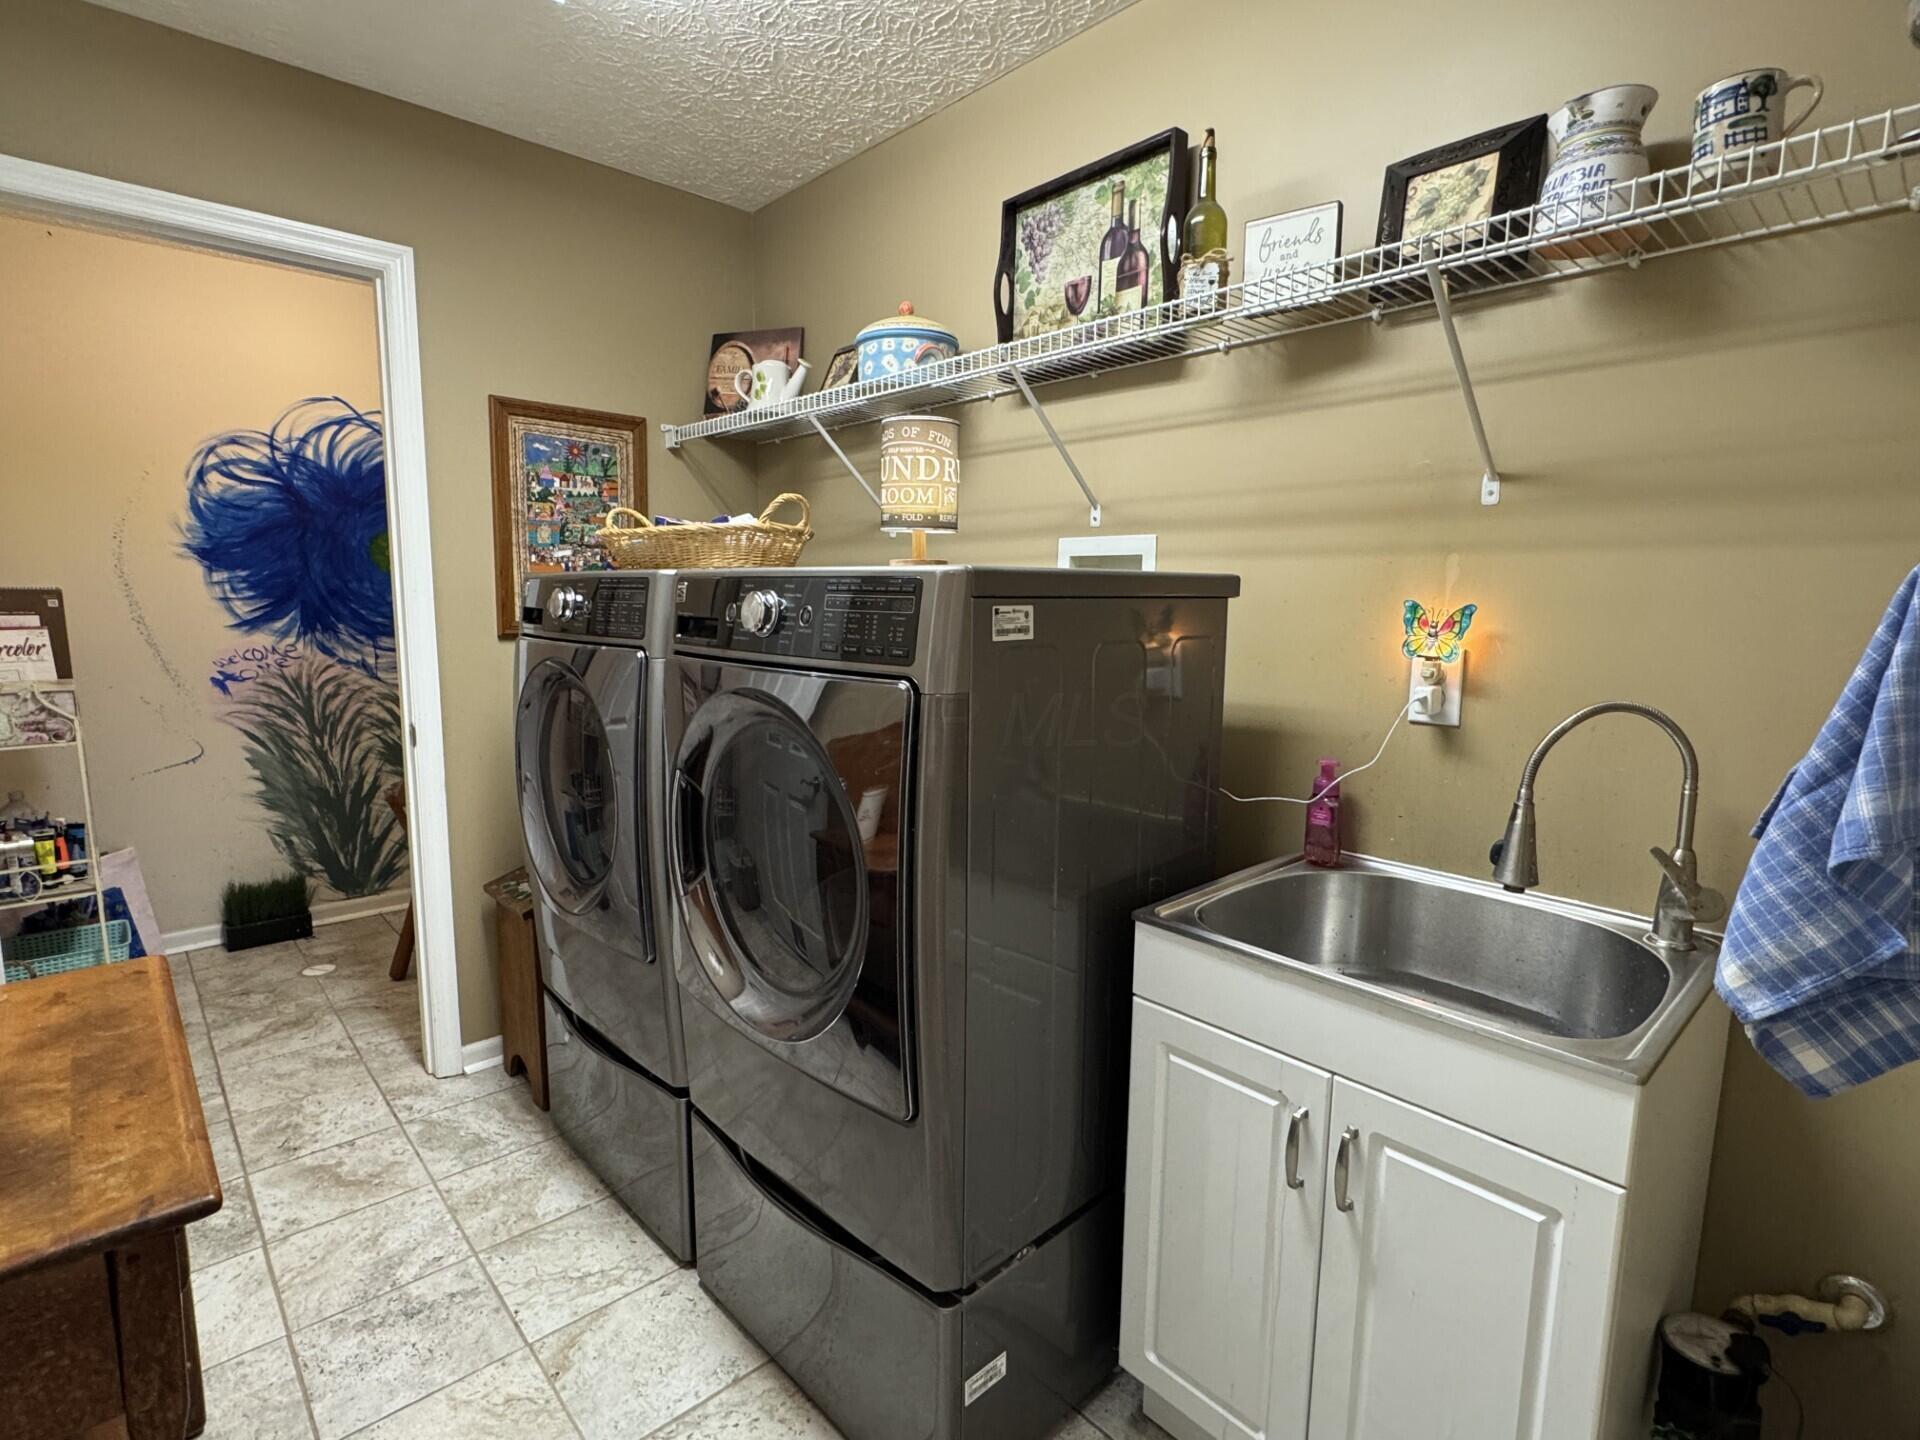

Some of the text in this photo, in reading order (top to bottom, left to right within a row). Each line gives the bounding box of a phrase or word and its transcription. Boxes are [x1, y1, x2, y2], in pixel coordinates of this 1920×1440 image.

[1259, 216, 1325, 263] friends
[901, 426, 920, 438] OF
[928, 430, 951, 448] FUN
[901, 513, 924, 521] FOLD
